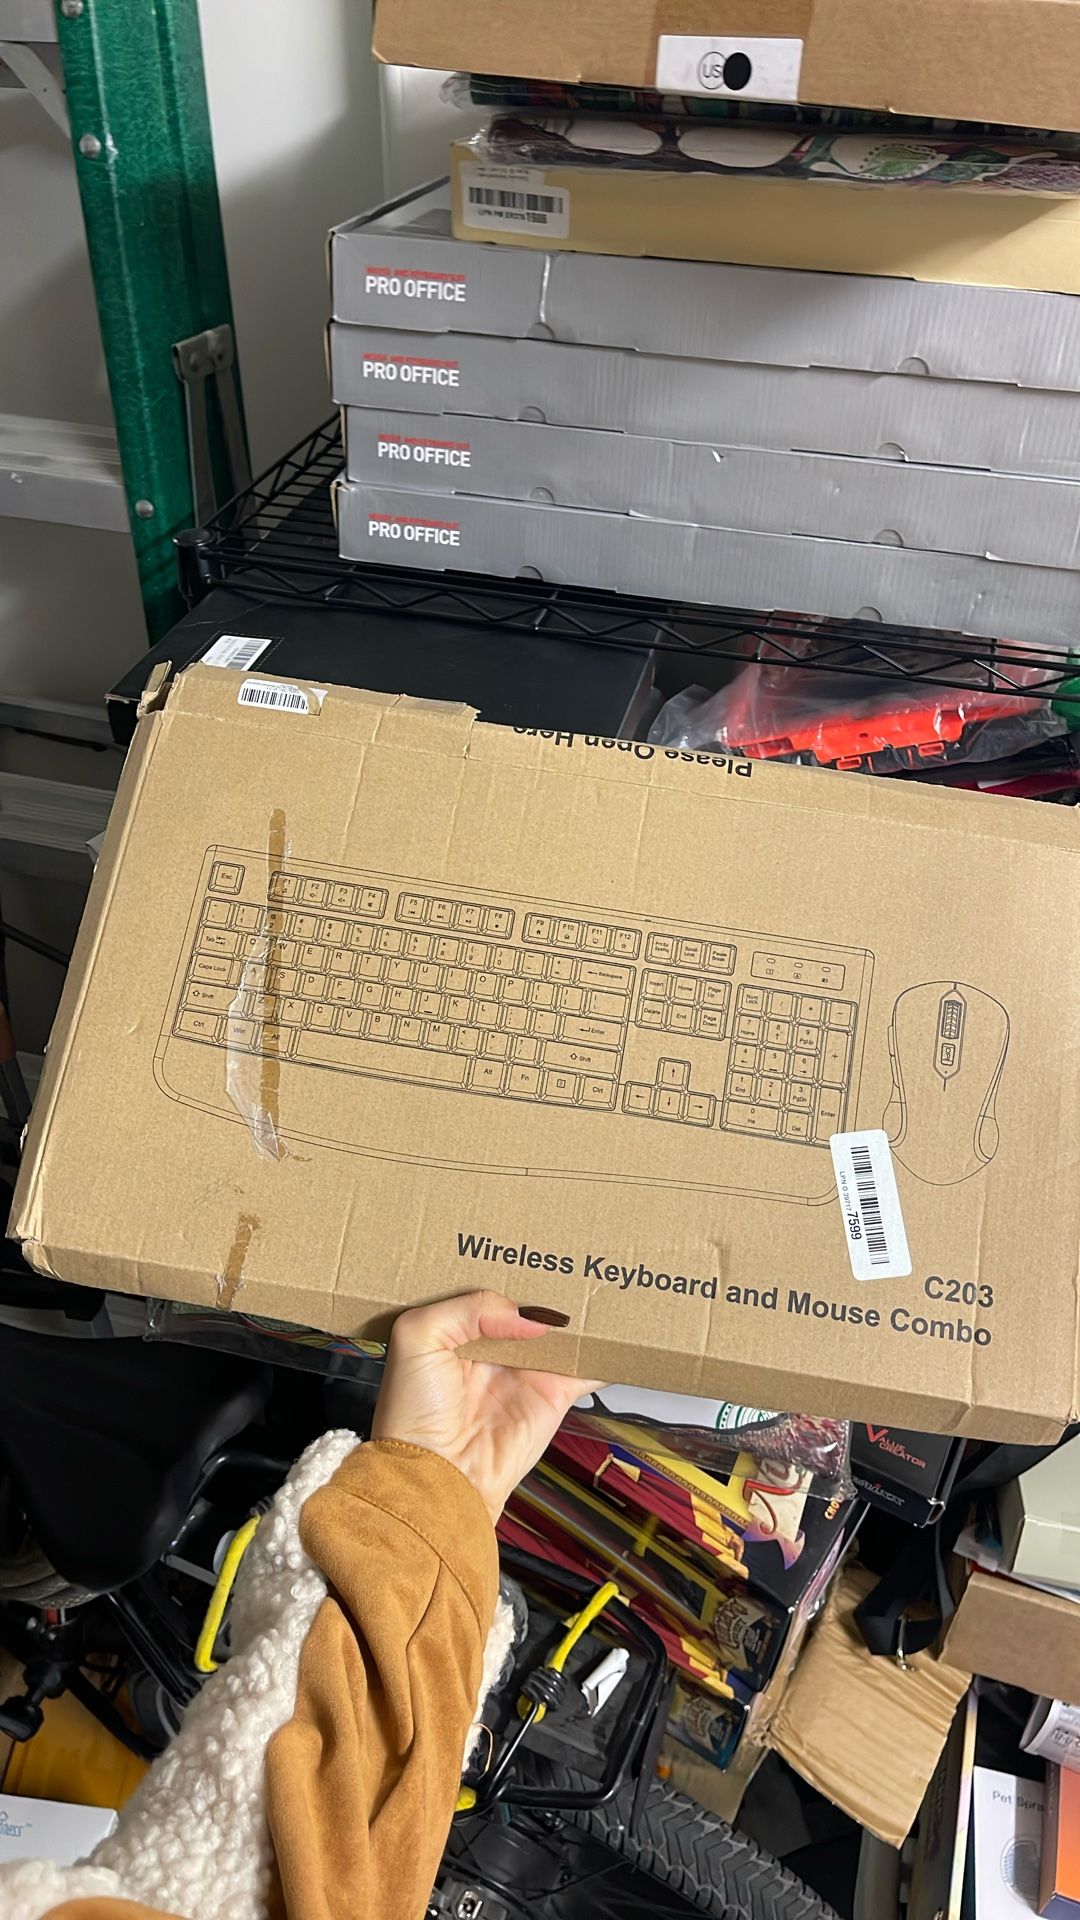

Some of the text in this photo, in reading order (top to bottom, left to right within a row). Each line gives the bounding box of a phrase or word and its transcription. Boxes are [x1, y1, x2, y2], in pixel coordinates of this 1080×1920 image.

[365, 275, 466, 302] PRO OFFICE
[362, 360, 398, 381] PRO
[399, 364, 460, 387] OFFICE
[377, 441, 411, 460] PRO
[413, 446, 472, 467] OFFICE
[368, 520, 401, 539] PRO
[403, 525, 460, 546] OFFICE
[664, 749, 753, 778] Please
[221, 872, 232, 880] Esc
[591, 928, 603, 936] F11
[198, 962, 213, 971] Caps
[422, 966, 429, 974] U
[279, 971, 286, 979] S
[479, 975, 487, 983] O
[649, 980, 664, 988] Insert
[287, 1001, 294, 1009] X
[316, 1006, 324, 1014] C
[643, 1007, 661, 1015] Delete
[703, 1014, 717, 1022] Page
[591, 1027, 605, 1035] Enter
[579, 1055, 592, 1063] Shift
[520, 1073, 530, 1081] Fn
[592, 1086, 604, 1094] Ctrl
[820, 1110, 836, 1118] Enter
[847, 1211, 862, 1240] 7599
[457, 1232, 992, 1346] Wireless Keyboard and Mouse Combo
[923, 1275, 994, 1308] C203
[879, 1442, 927, 1469] CREATOR
[992, 1790, 1012, 1804] Pet
